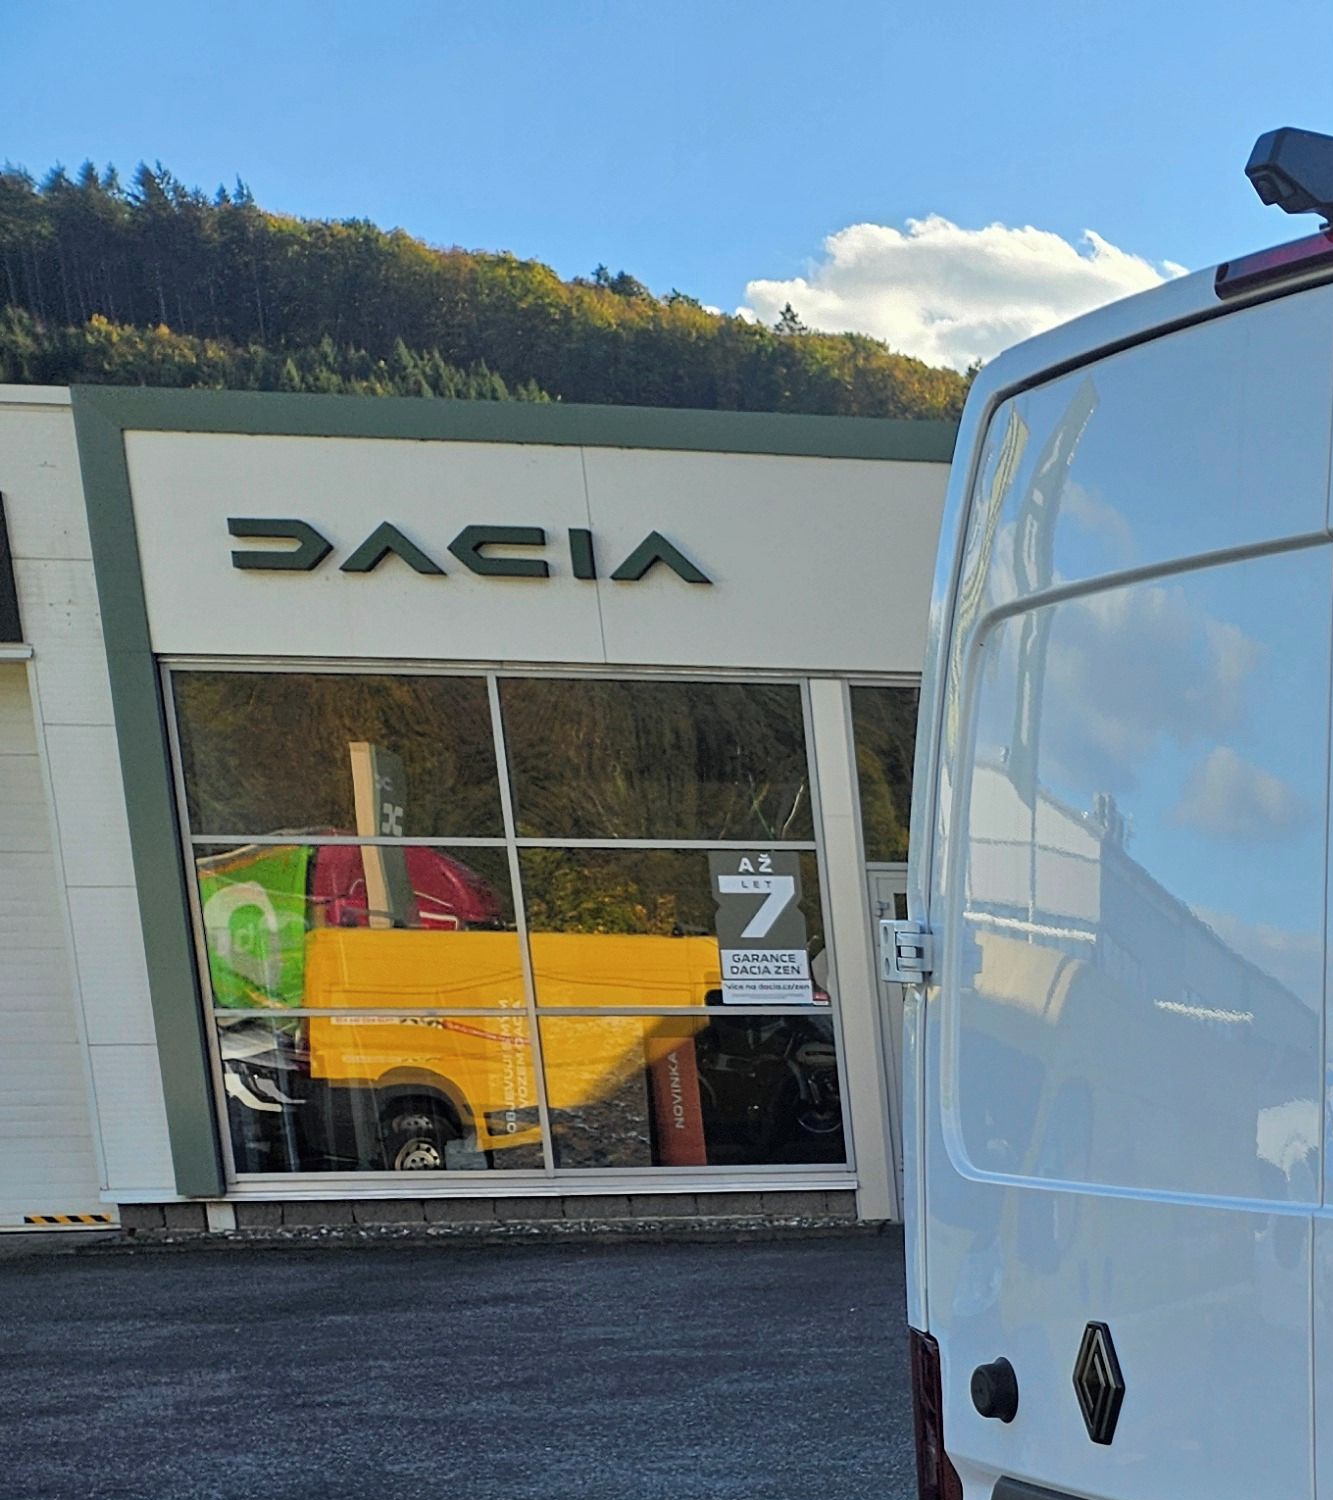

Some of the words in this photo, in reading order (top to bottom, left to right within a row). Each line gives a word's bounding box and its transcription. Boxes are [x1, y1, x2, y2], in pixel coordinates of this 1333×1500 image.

[226, 517, 714, 584] DACIA
[738, 853, 773, 873] AŽ
[741, 881, 772, 889] LET
[718, 875, 795, 938] 7
[730, 966, 771, 975] DACIA
[774, 965, 801, 975] ZEN
[732, 954, 796, 963] GARANCE
[512, 1000, 524, 1049] DACA
[667, 1052, 685, 1129] NOVINKA
